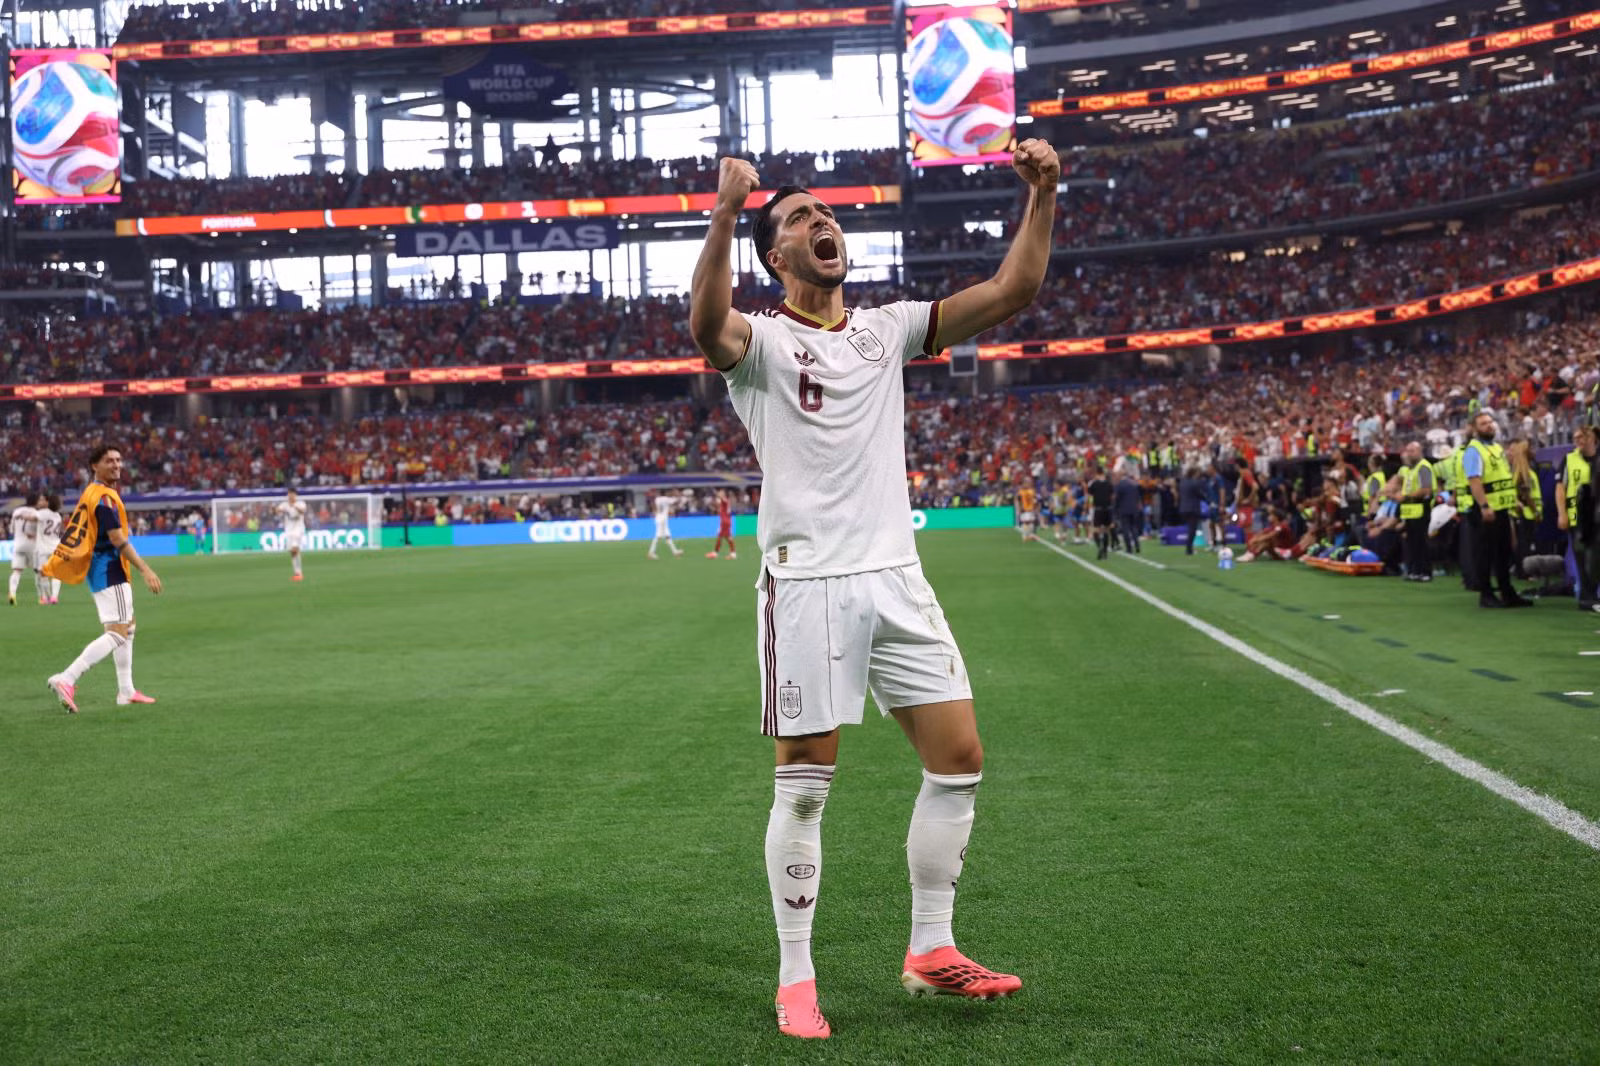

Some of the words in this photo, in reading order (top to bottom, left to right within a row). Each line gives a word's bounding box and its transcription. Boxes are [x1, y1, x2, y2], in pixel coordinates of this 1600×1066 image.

[493, 63, 526, 76] FIFA
[468, 78, 522, 90] WORLD
[524, 75, 555, 89] CUP
[202, 216, 257, 230] PORTUGAL
[415, 225, 607, 255] DALLAS
[799, 370, 823, 412] 6
[260, 529, 365, 551] armco
